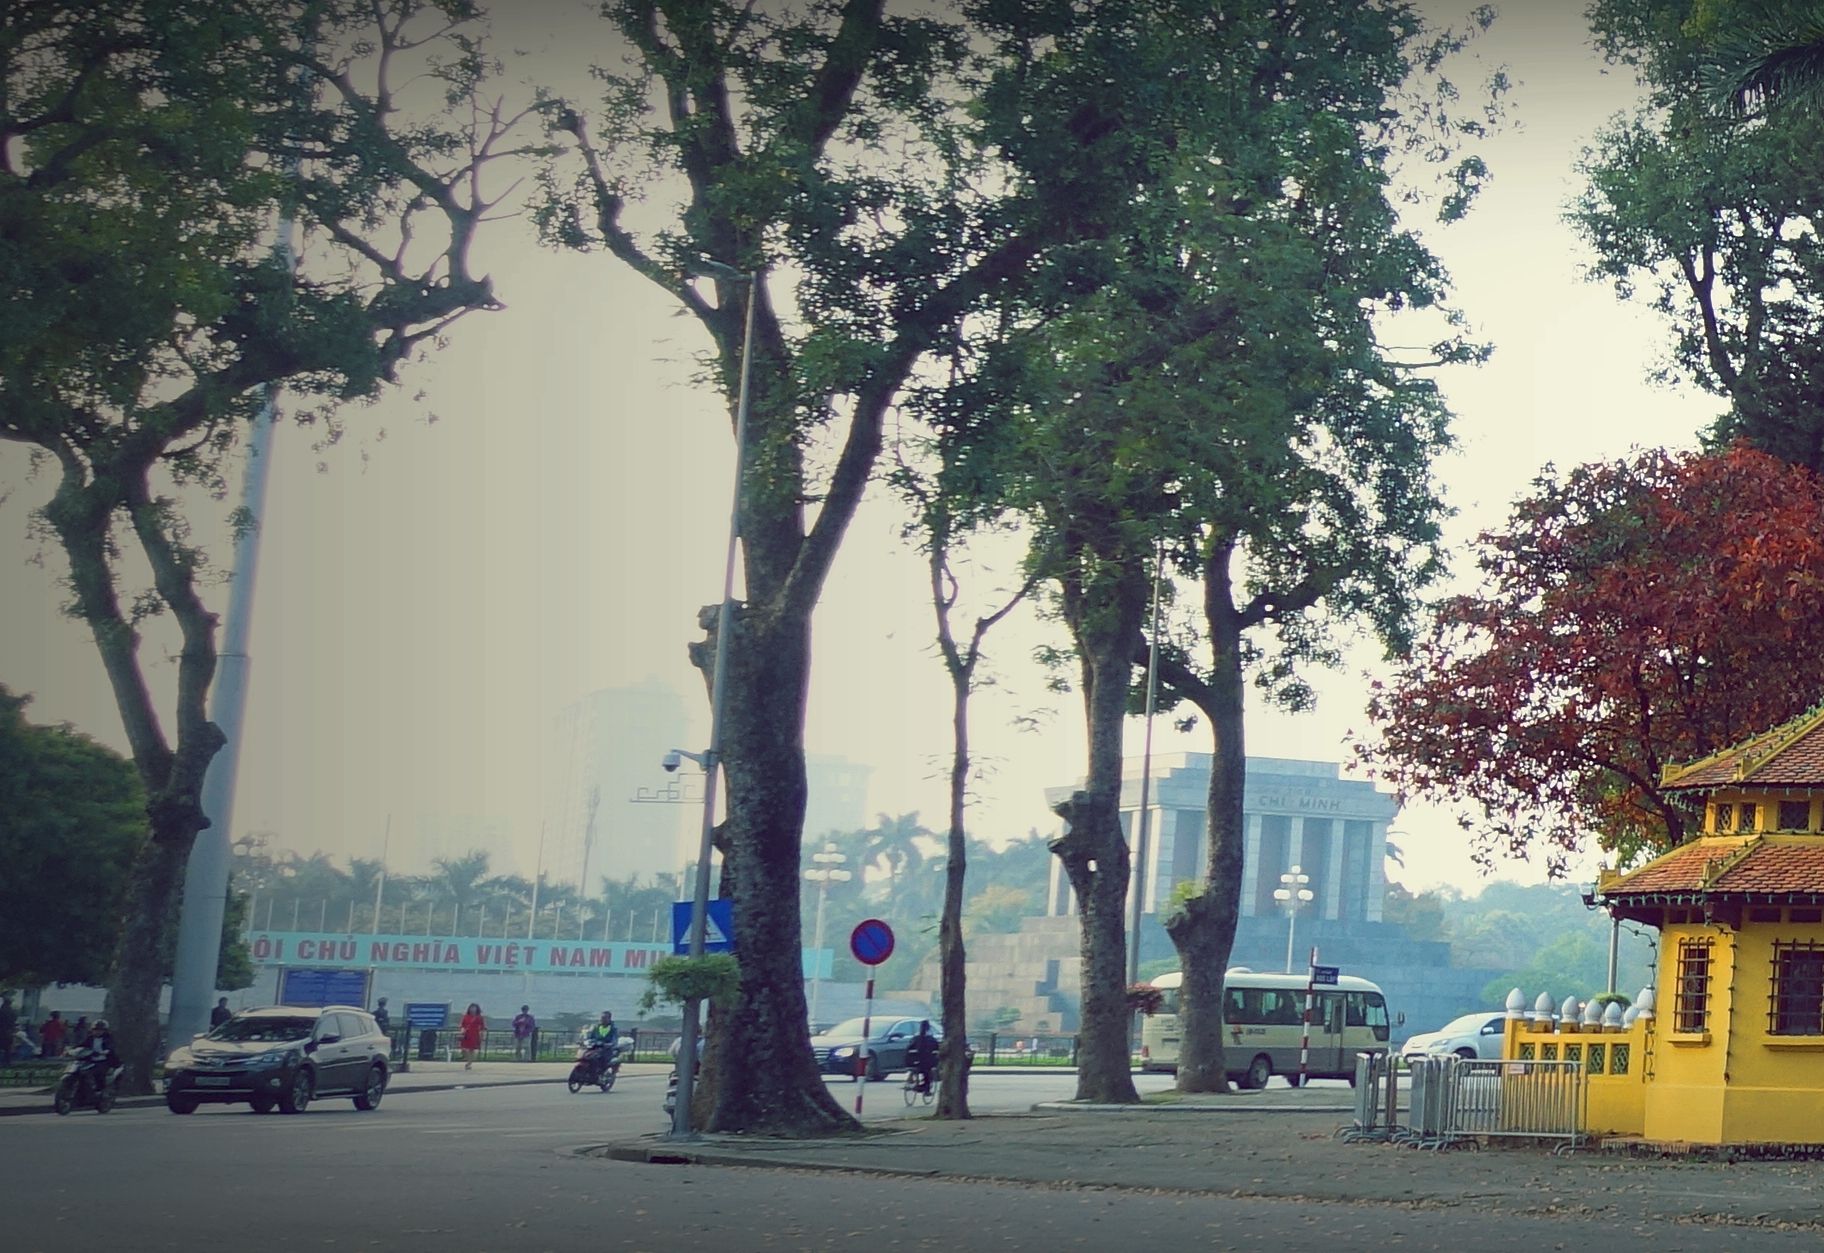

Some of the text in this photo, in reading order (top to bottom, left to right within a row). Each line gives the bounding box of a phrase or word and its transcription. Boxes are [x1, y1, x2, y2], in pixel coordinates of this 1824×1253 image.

[254, 934, 284, 963] ỘI
[298, 935, 357, 961] CHỦ
[370, 939, 461, 963] NGHĨA
[477, 942, 538, 969] VIỆT
[550, 946, 613, 968] NAM
